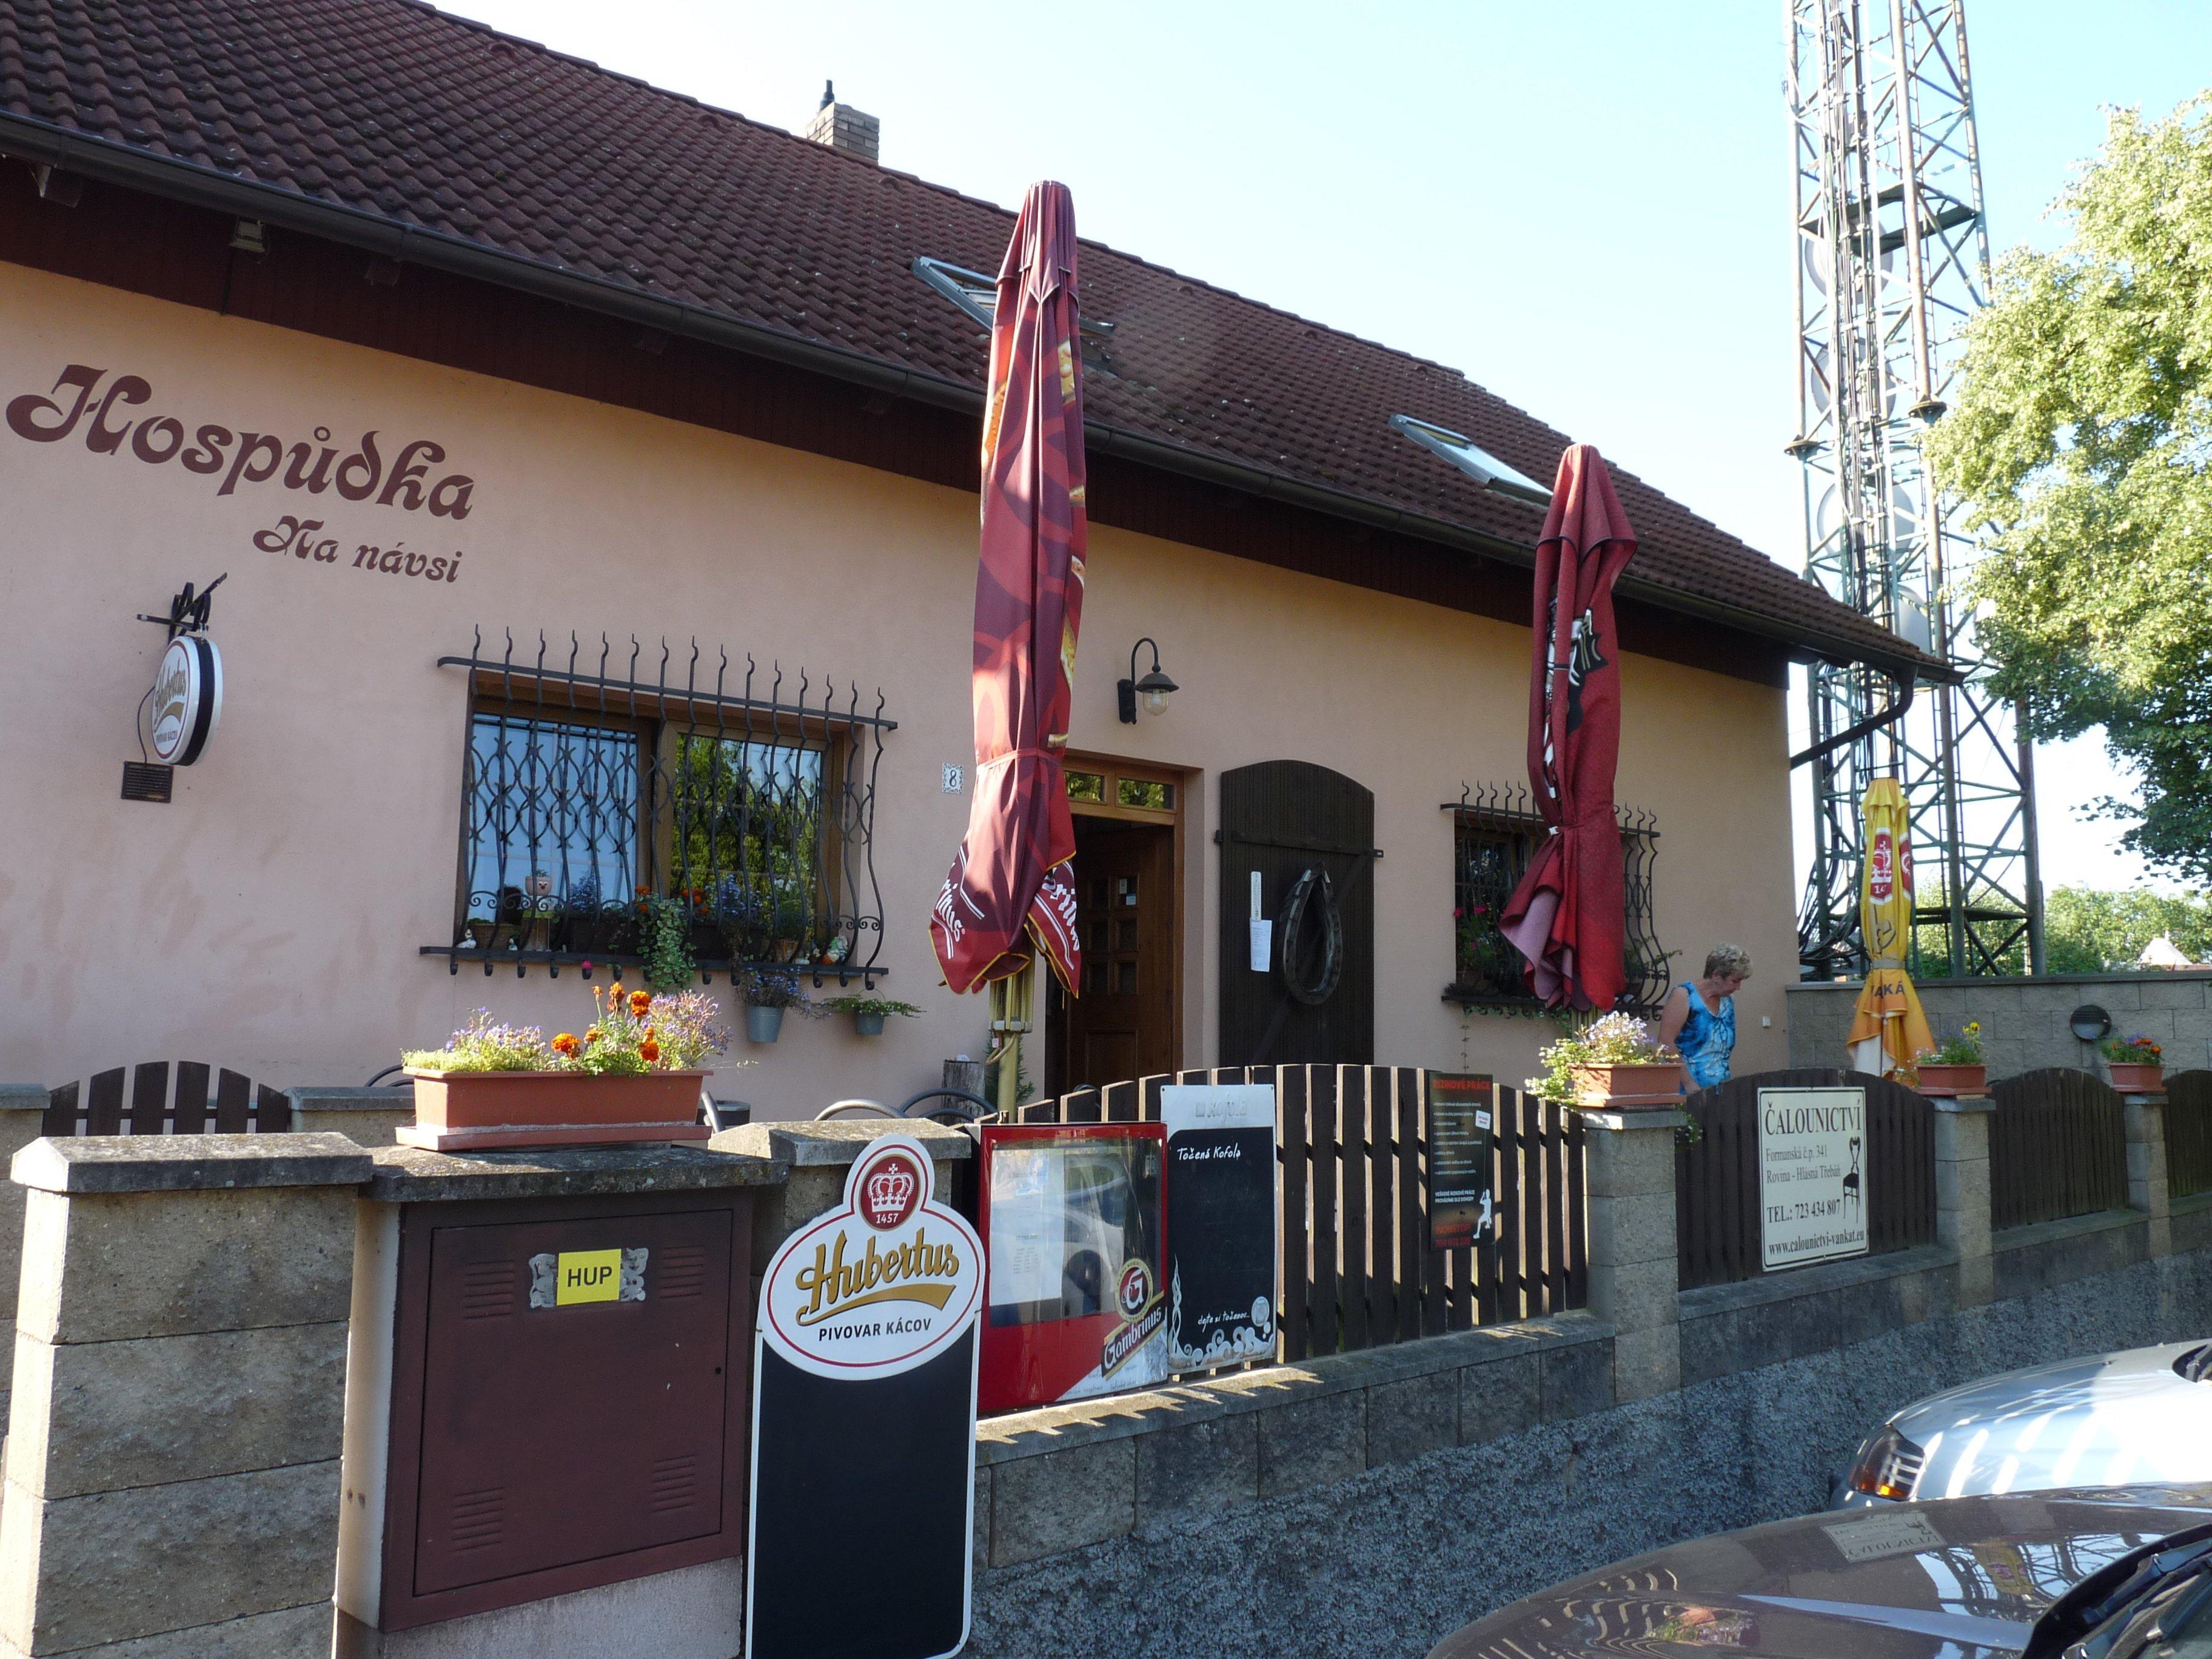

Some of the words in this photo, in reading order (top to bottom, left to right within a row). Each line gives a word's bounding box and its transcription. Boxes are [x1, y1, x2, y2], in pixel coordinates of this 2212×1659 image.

[6, 364, 475, 520] Hospůdka
[253, 515, 339, 564] Na
[352, 541, 463, 583] návsi
[949, 769, 957, 787] 8
[1765, 1099, 1861, 1135] ČALOUNICTVÍ
[1213, 1142, 1241, 1161] Kofola
[1766, 1147, 1802, 1162] Formanská
[1766, 1168, 1791, 1184] Rovina
[1796, 1166, 1818, 1181] Hlásná
[876, 1213, 899, 1224] 1457
[1767, 1205, 1792, 1223] TEL.:
[1795, 1202, 1809, 1220] 723
[1811, 1201, 1825, 1218] 434
[1827, 1199, 1841, 1216] 807
[568, 1266, 612, 1287] HUP
[795, 1227, 960, 1315] Hubertus
[819, 1324, 881, 1341] PIVOVAR
[886, 1317, 931, 1335] KÁCOV
[1104, 1307, 1162, 1370] Gambrinus
